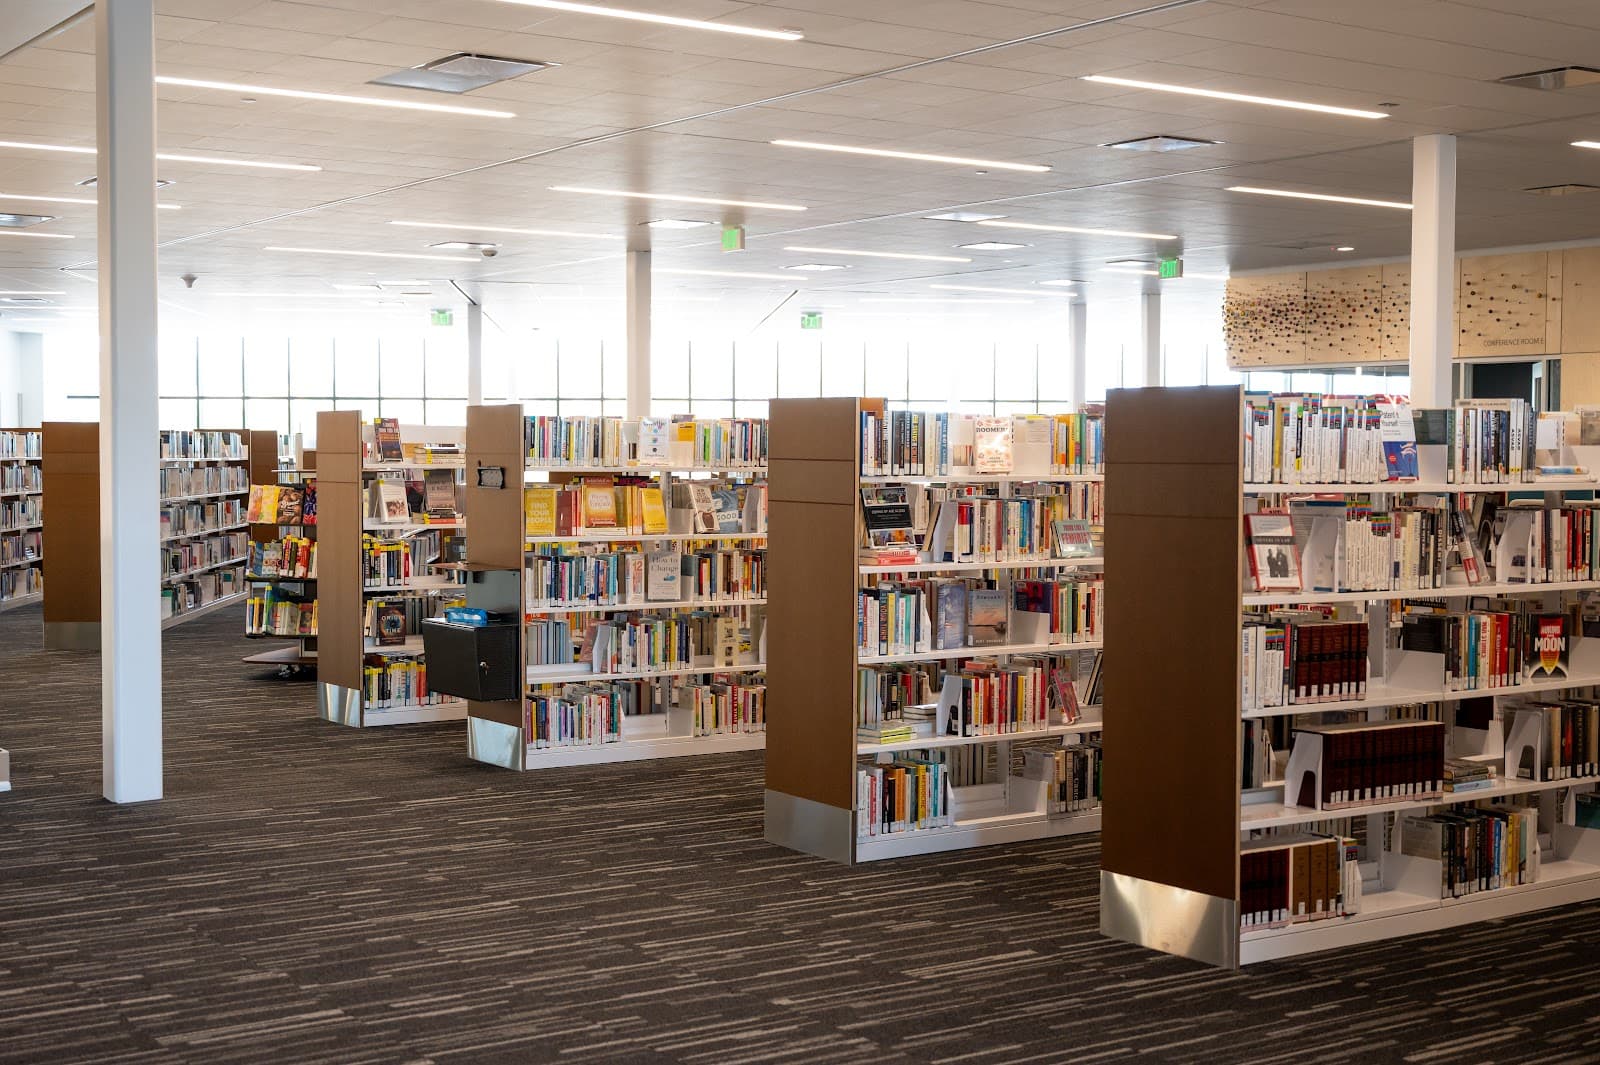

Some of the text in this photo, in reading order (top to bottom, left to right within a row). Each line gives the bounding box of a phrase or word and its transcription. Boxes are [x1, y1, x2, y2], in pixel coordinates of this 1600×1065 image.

[1483, 338, 1520, 347] CONFERENCE
[1520, 337, 1539, 345] ROOM
[651, 555, 668, 563] How
[651, 564, 679, 574] Change
[1534, 636, 1565, 652] MOON
